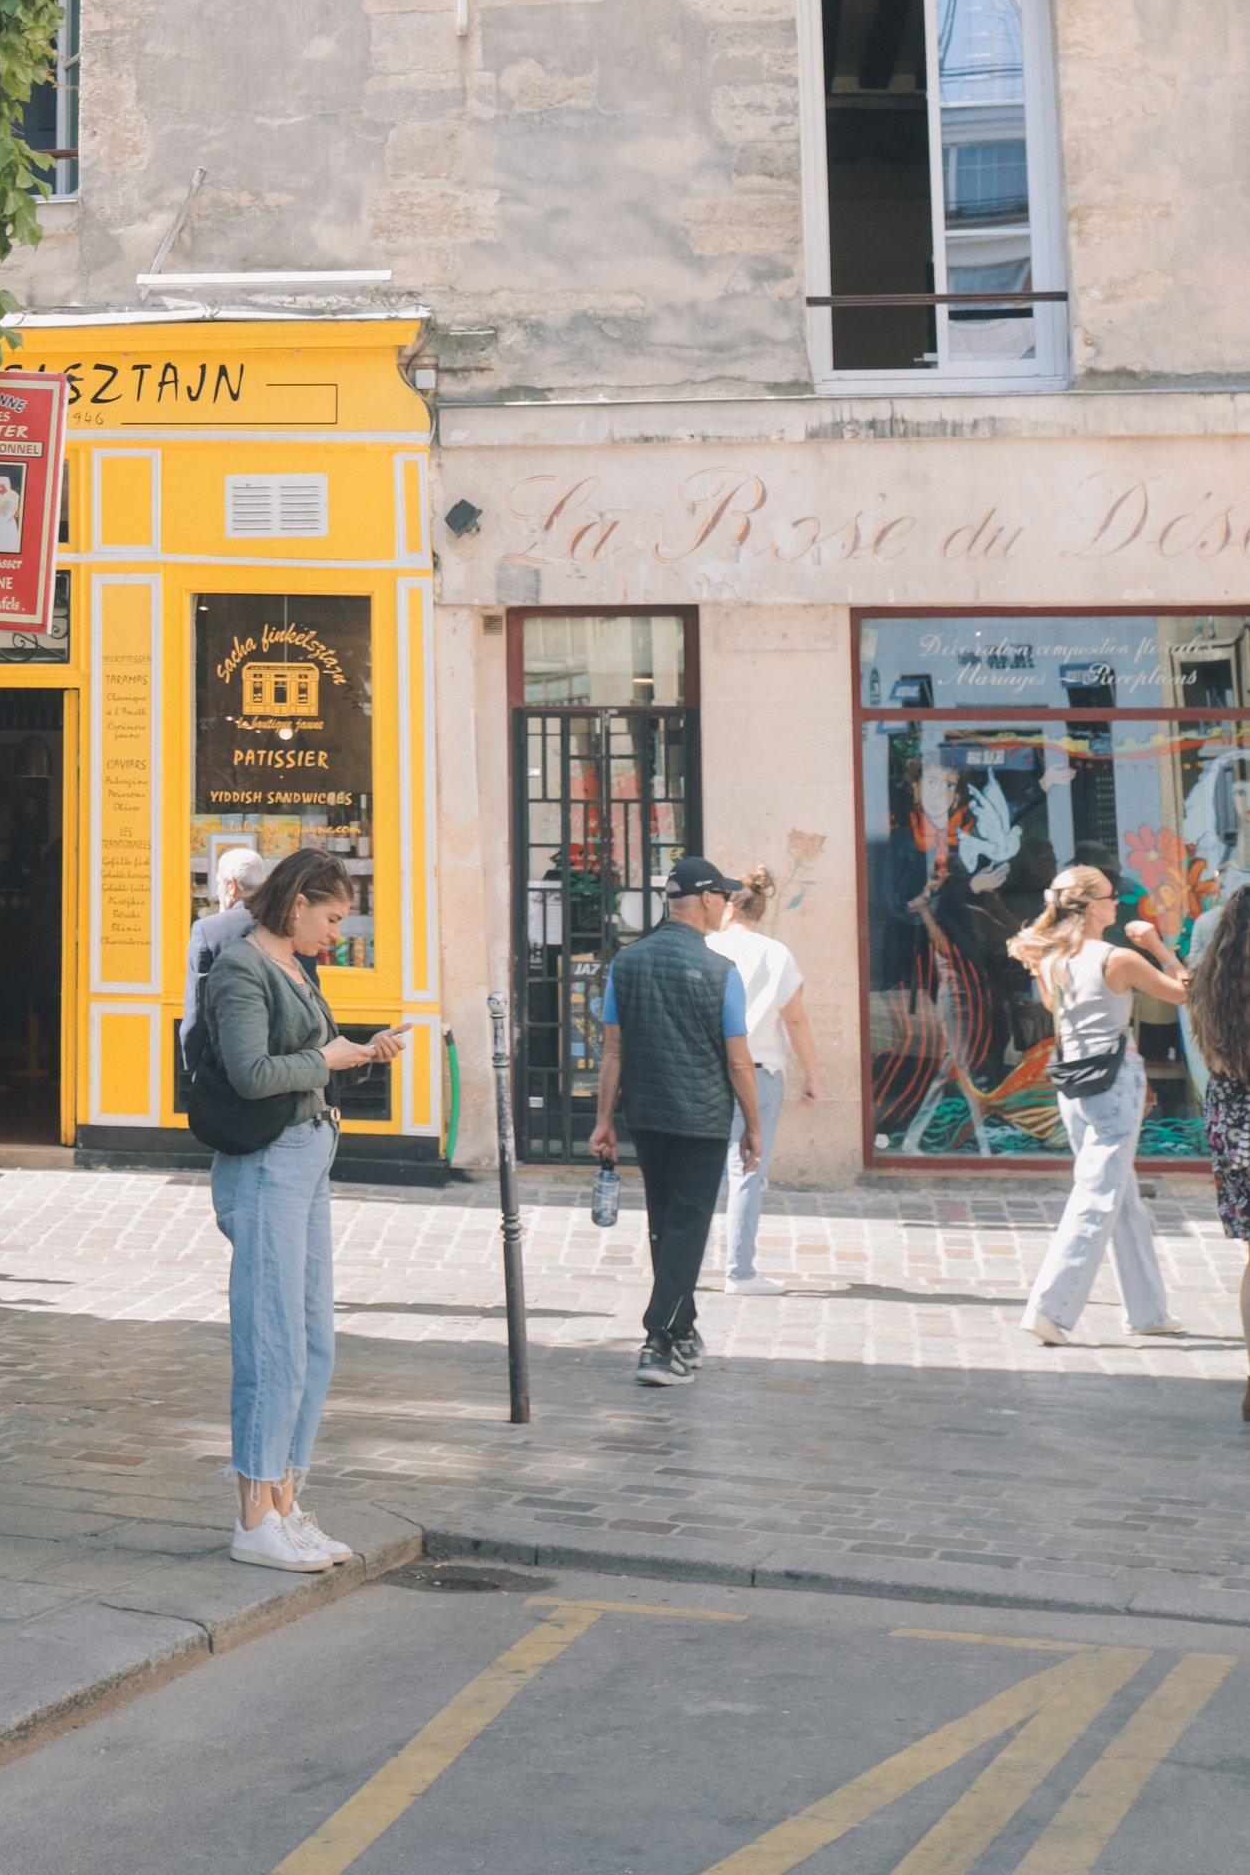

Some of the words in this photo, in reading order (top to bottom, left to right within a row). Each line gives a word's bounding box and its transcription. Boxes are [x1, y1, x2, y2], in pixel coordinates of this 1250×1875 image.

[4, 362, 244, 404] SZTAJN
[73, 412, 104, 426] 946
[502, 475, 623, 564] La
[652, 467, 916, 564] Rose
[939, 507, 1023, 562] du
[217, 635, 257, 684] Sacha
[106, 674, 148, 685] TARAMAS
[252, 715, 293, 734] boutique
[295, 718, 325, 733] jaune
[107, 758, 147, 770] CAVIARS
[233, 749, 329, 769] PATISSIER
[210, 791, 262, 804] YIDDISH
[267, 791, 353, 806] SANDWICHES
